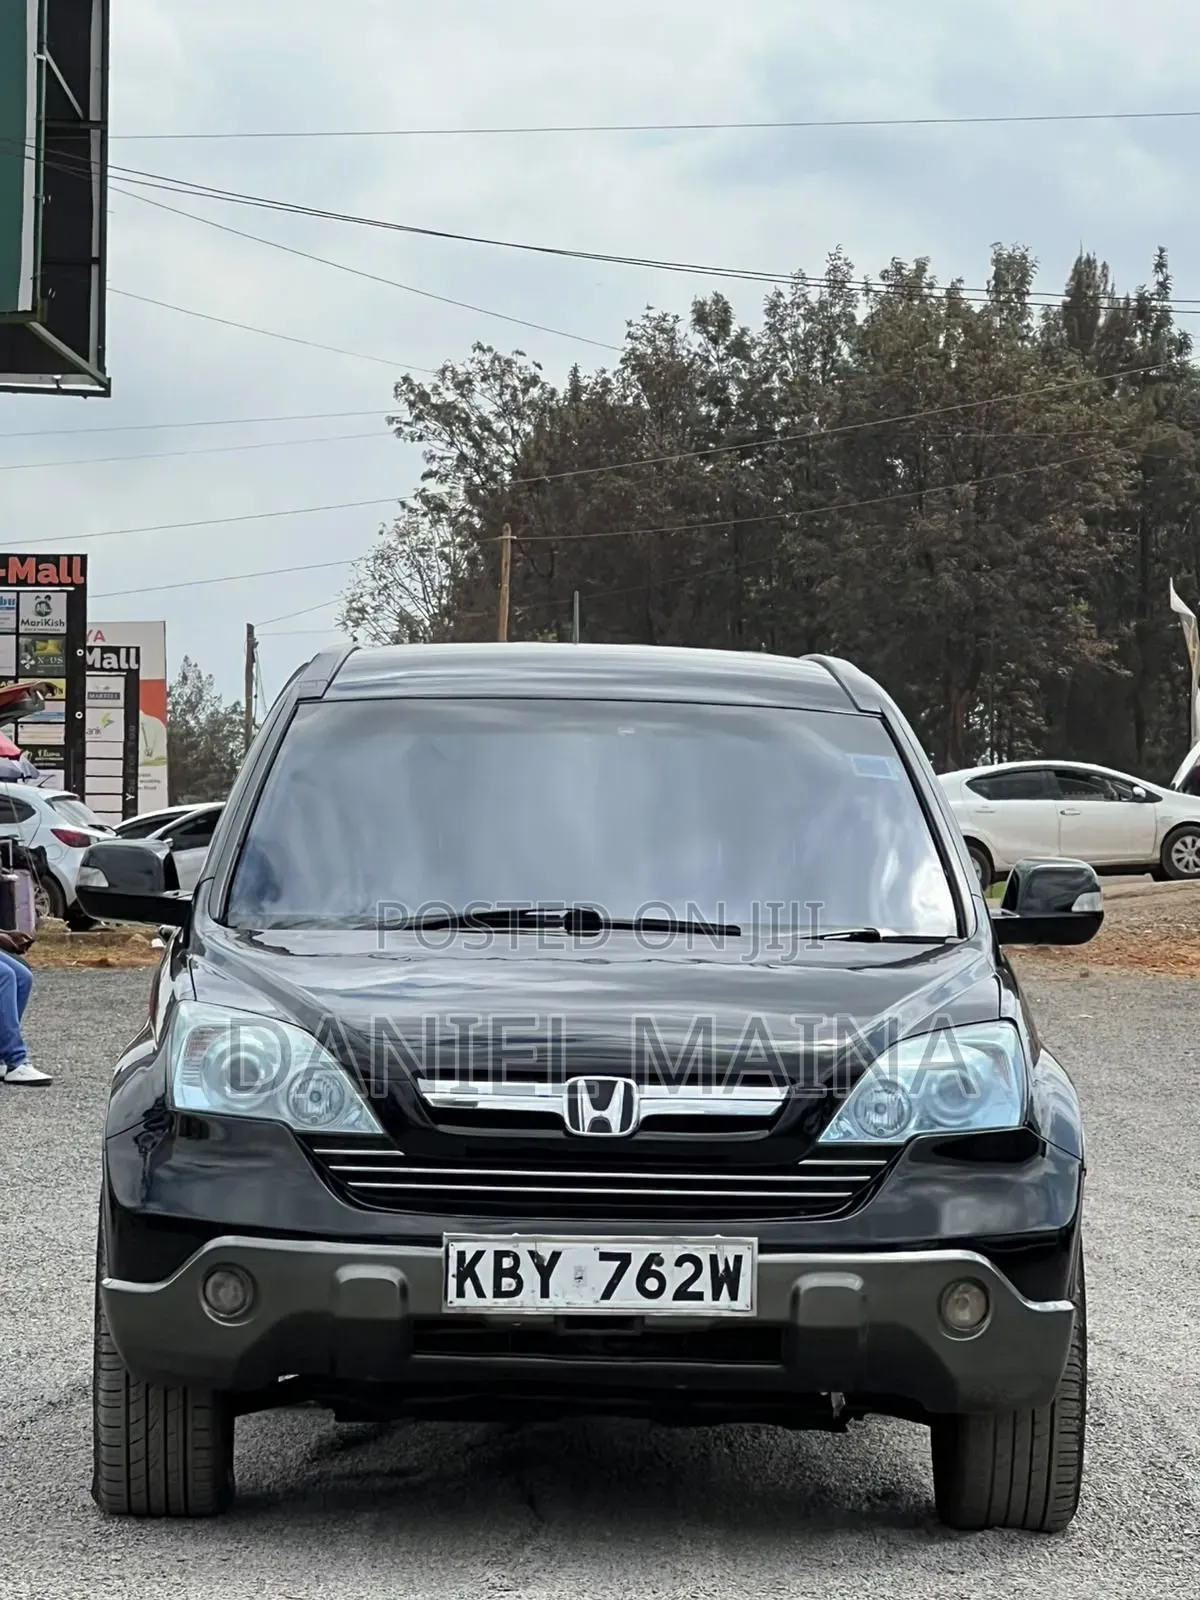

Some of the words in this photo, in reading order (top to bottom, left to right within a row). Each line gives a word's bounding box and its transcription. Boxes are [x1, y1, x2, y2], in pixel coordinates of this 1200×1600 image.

[21, 618, 65, 627] MariKish
[86, 647, 139, 669] Mall
[455, 1249, 563, 1299] KBY
[598, 1251, 744, 1302] 762W
